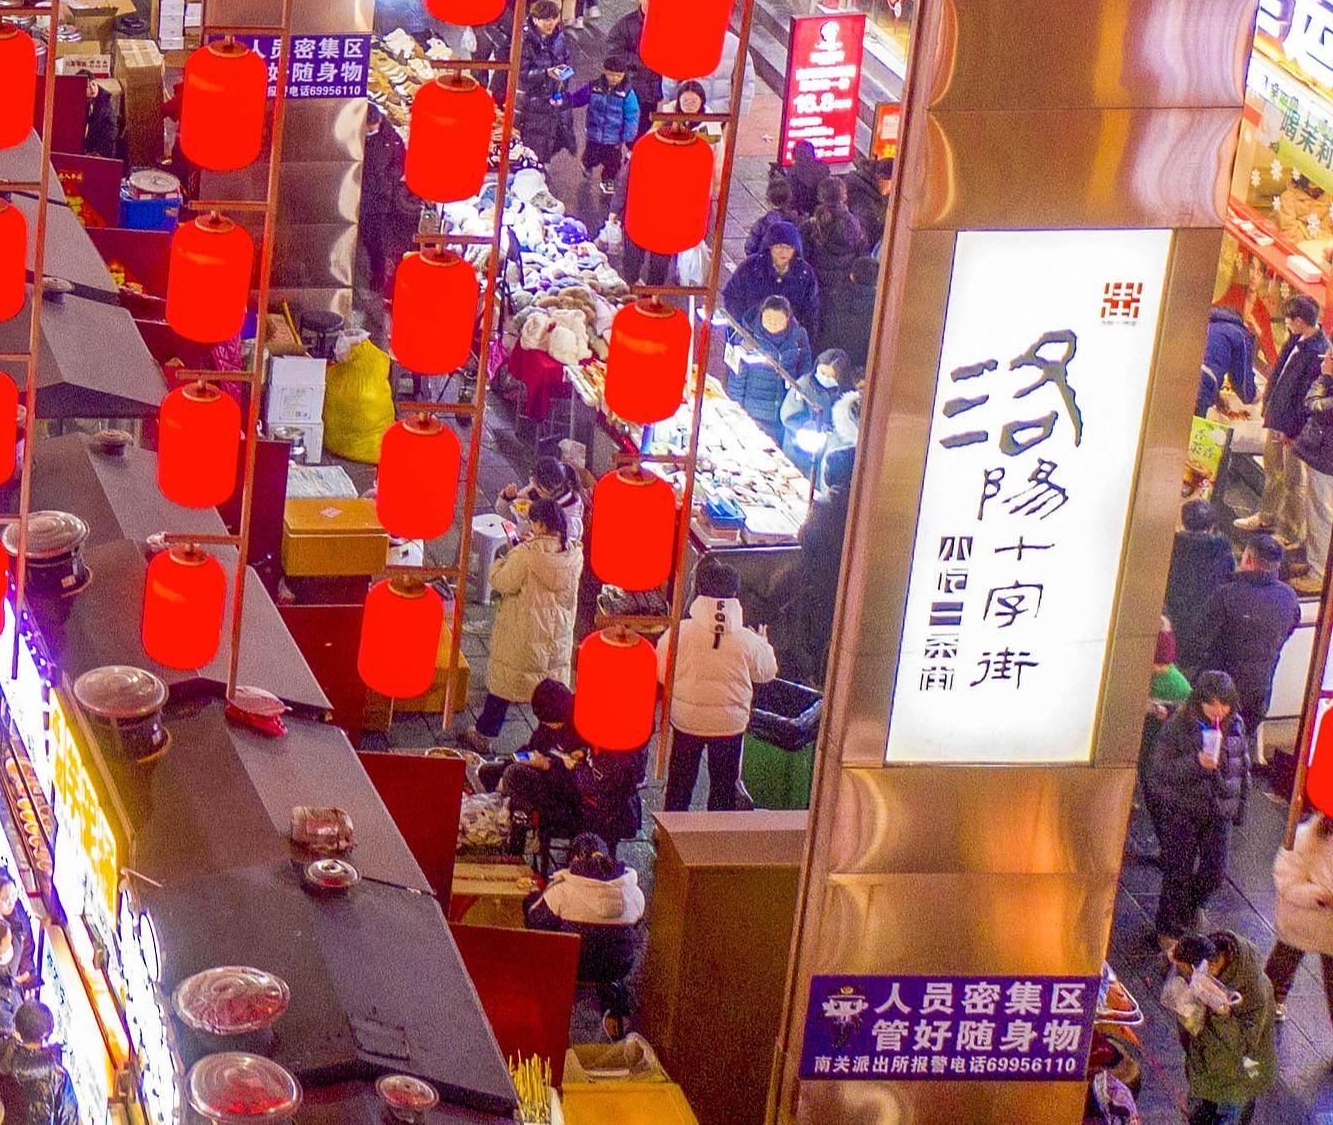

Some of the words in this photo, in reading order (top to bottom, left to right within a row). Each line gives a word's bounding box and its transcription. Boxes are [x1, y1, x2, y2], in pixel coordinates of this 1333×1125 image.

[267, 62, 362, 83] 好随身物
[267, 86, 361, 97] 报电话69956110
[874, 982, 1086, 1015] 人员密集区
[871, 1019, 1082, 1052] 管好随身物
[814, 1056, 1076, 1074] 南关派出所报警电话69956110
